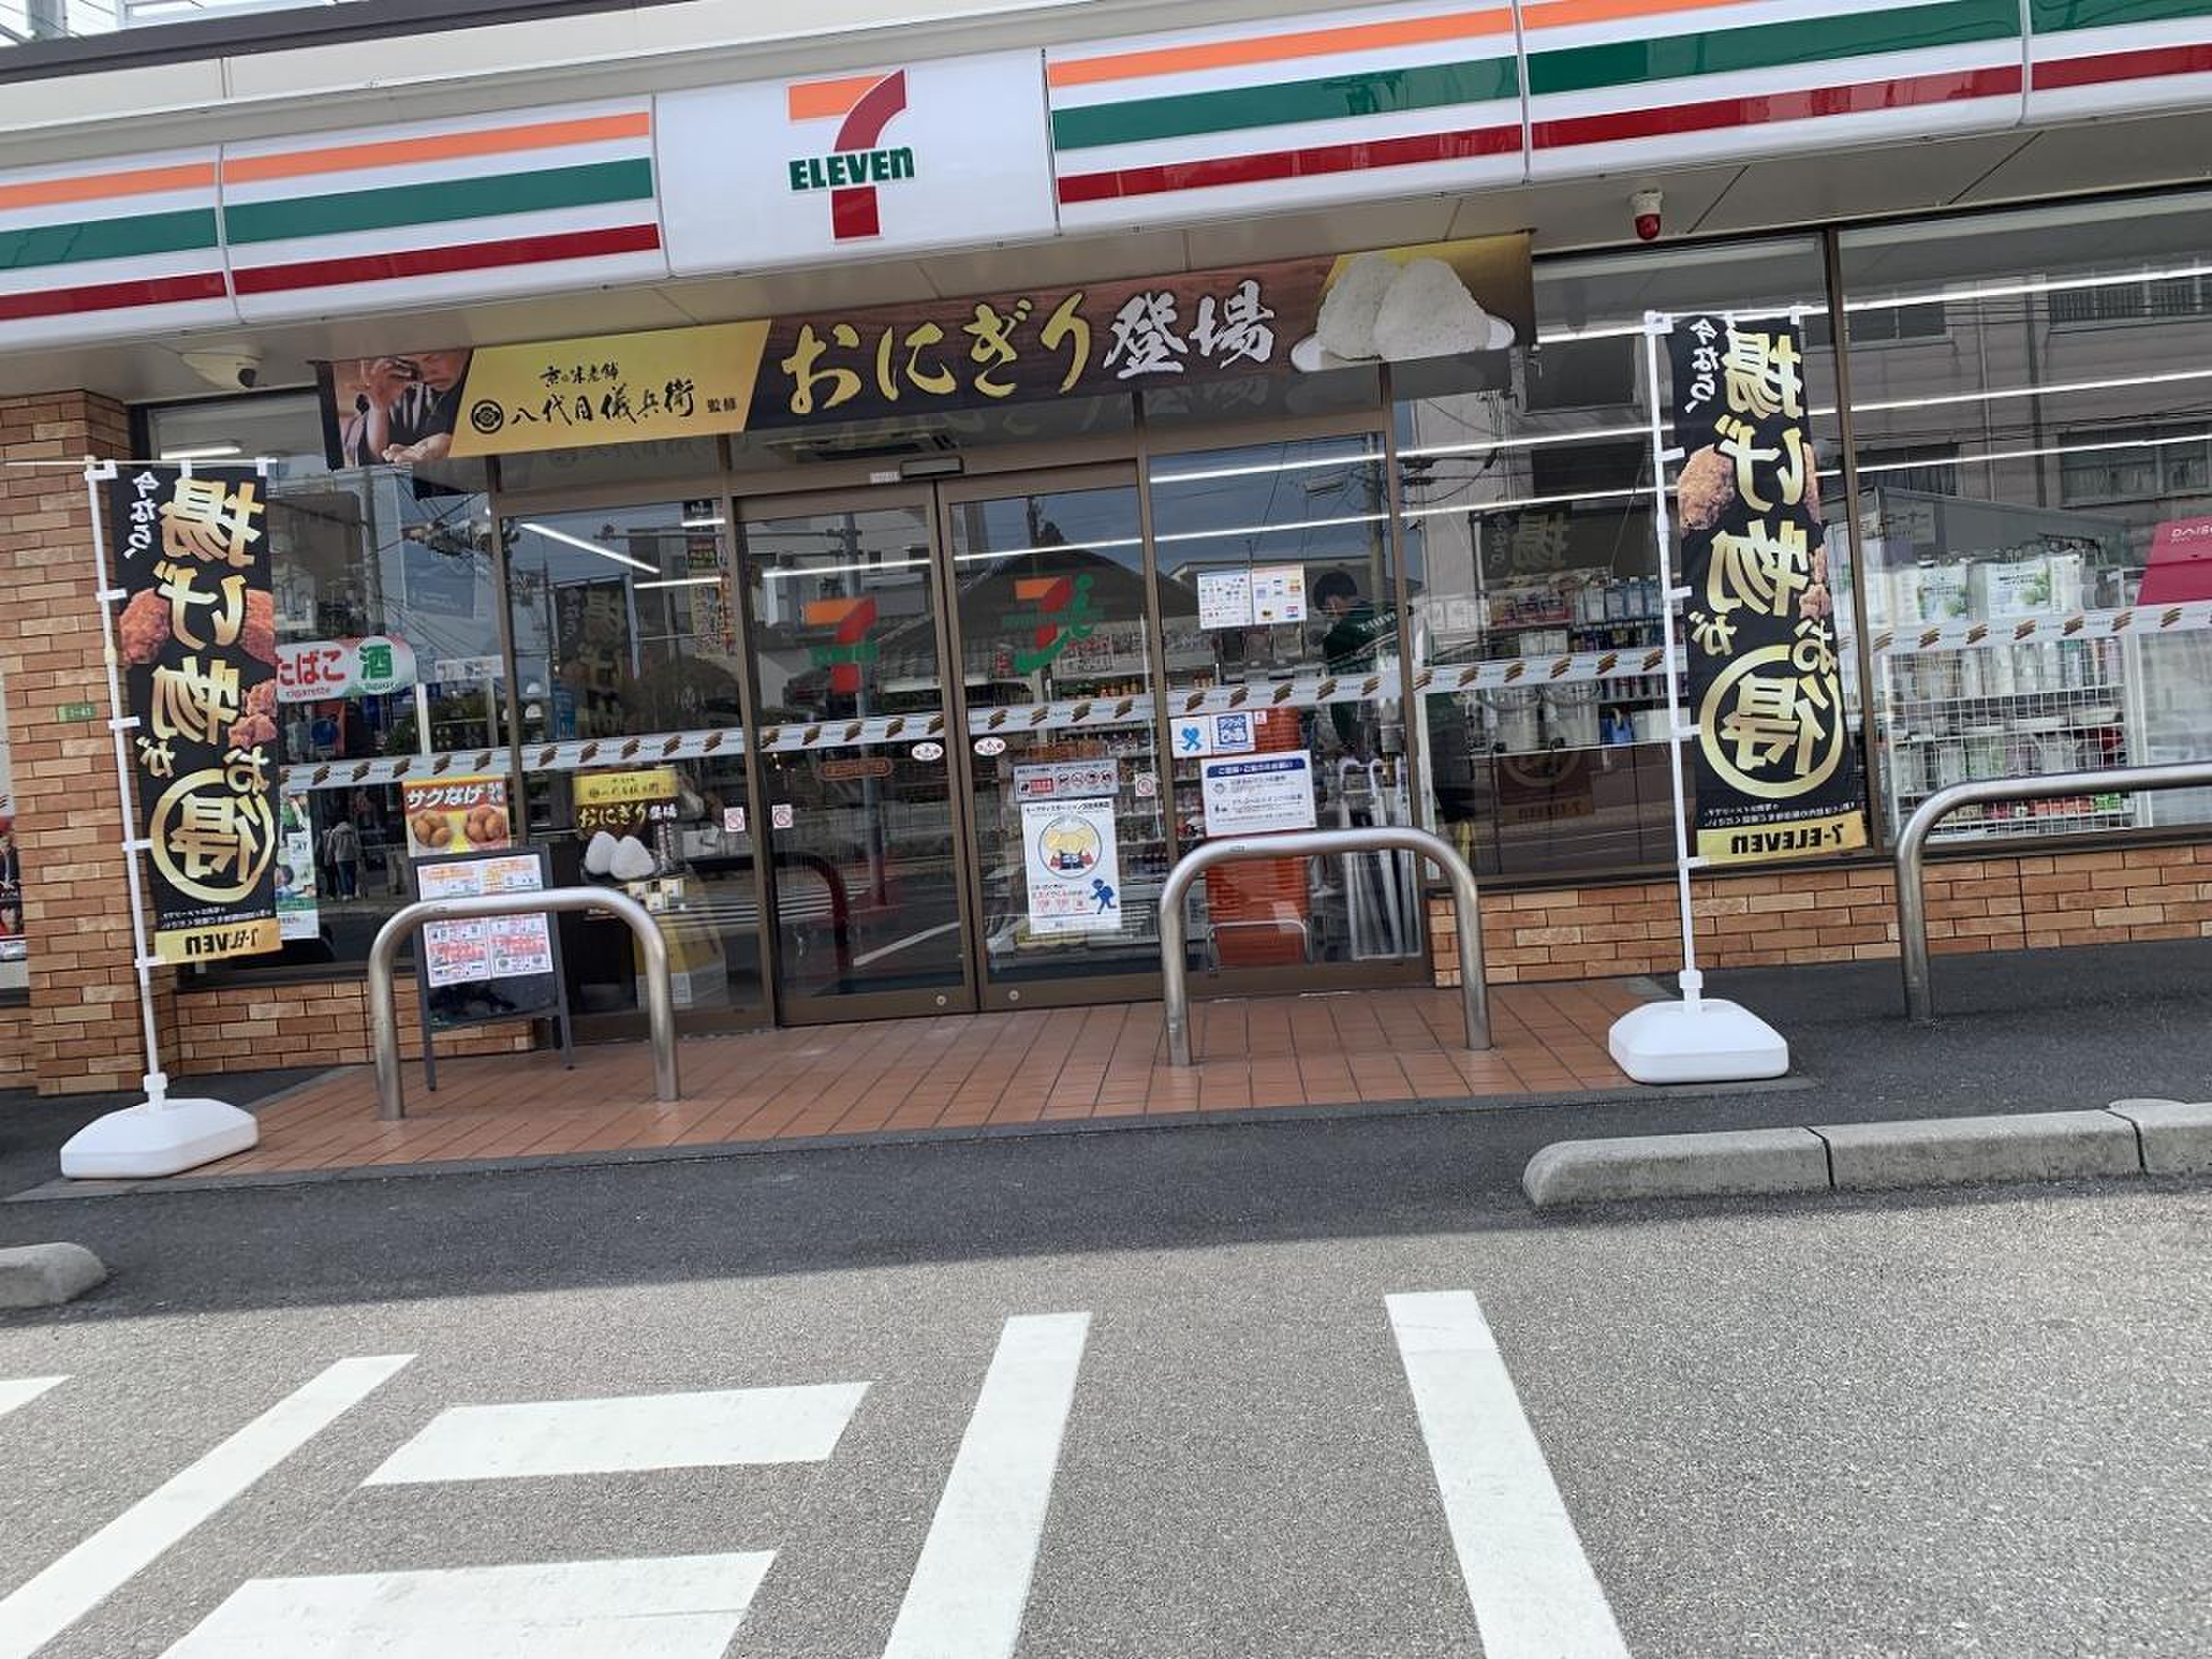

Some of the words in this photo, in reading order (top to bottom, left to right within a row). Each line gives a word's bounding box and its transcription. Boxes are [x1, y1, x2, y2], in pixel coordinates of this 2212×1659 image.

[782, 279, 1277, 414] おにぎり登場
[359, 644, 393, 680] 酒
